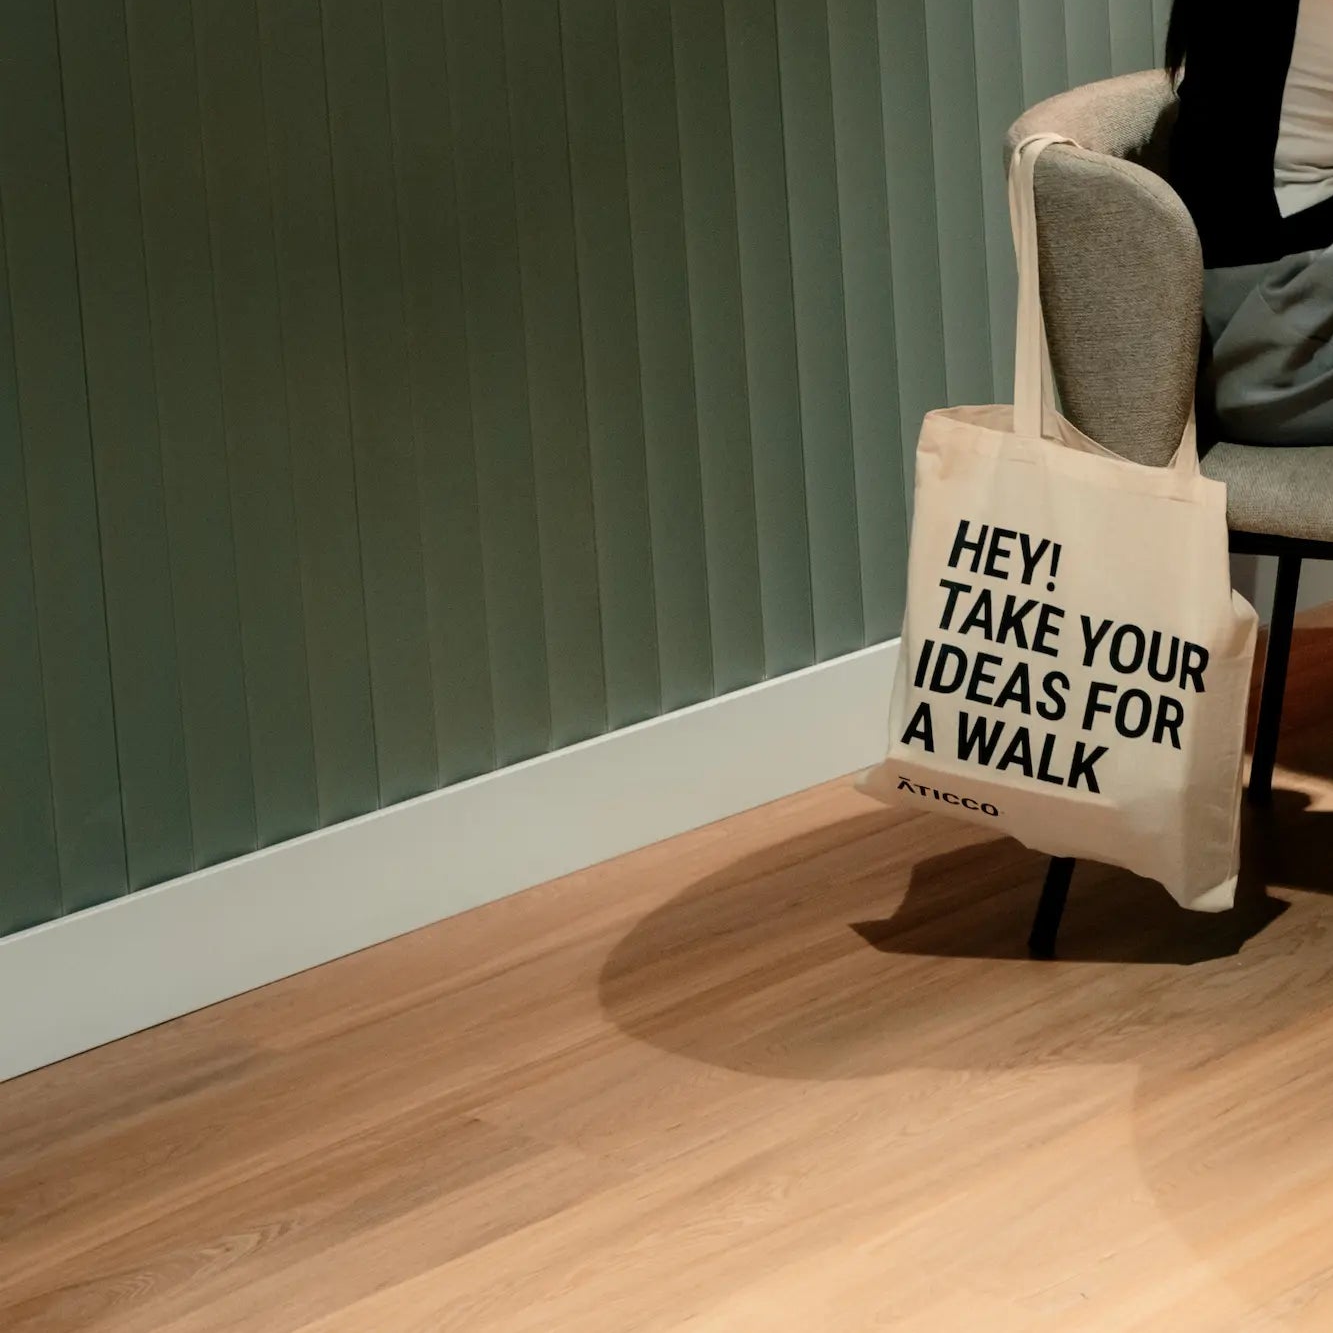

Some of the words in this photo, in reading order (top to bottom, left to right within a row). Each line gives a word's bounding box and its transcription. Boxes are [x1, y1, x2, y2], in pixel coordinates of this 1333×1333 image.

[947, 519, 1062, 592] HEY!
[939, 578, 1065, 658] TAKE
[1080, 614, 1210, 693] YOUR
[914, 639, 1071, 722] IDEAS
[1082, 682, 1185, 750] FOR
[900, 701, 935, 753] A
[957, 710, 1109, 794] WALK
